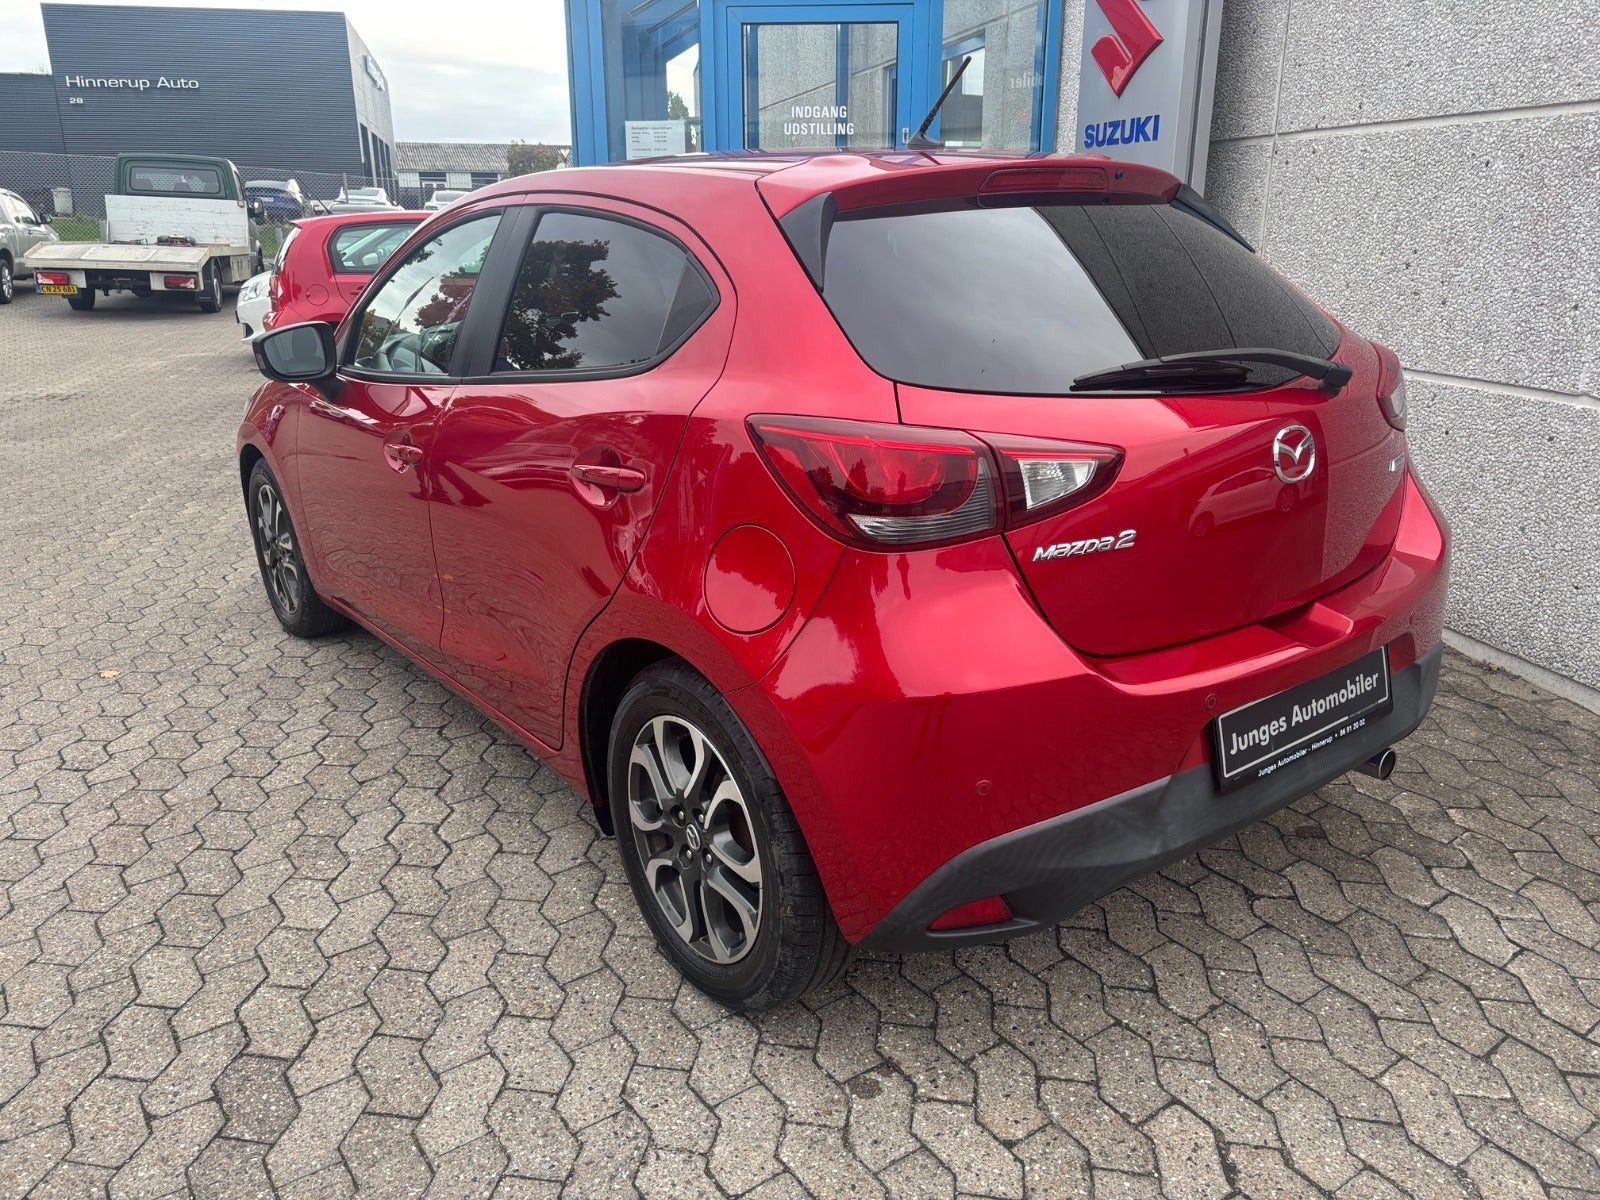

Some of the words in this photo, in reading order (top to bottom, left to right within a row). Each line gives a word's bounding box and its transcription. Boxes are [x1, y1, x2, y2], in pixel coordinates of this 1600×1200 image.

[65, 75, 150, 91] Hinnerup
[156, 76, 199, 89] Auto
[791, 105, 847, 118] INDGANG
[784, 122, 854, 135] UDSTILLING
[1083, 114, 1161, 149] SUZUKI
[52, 285, 62, 293] 25
[1229, 714, 1288, 756] Junges
[1291, 672, 1379, 726] Automobiler
[1258, 764, 1277, 777] Junges
[1277, 747, 1308, 767] Automobiler
[1311, 736, 1333, 750] Hinnerup
